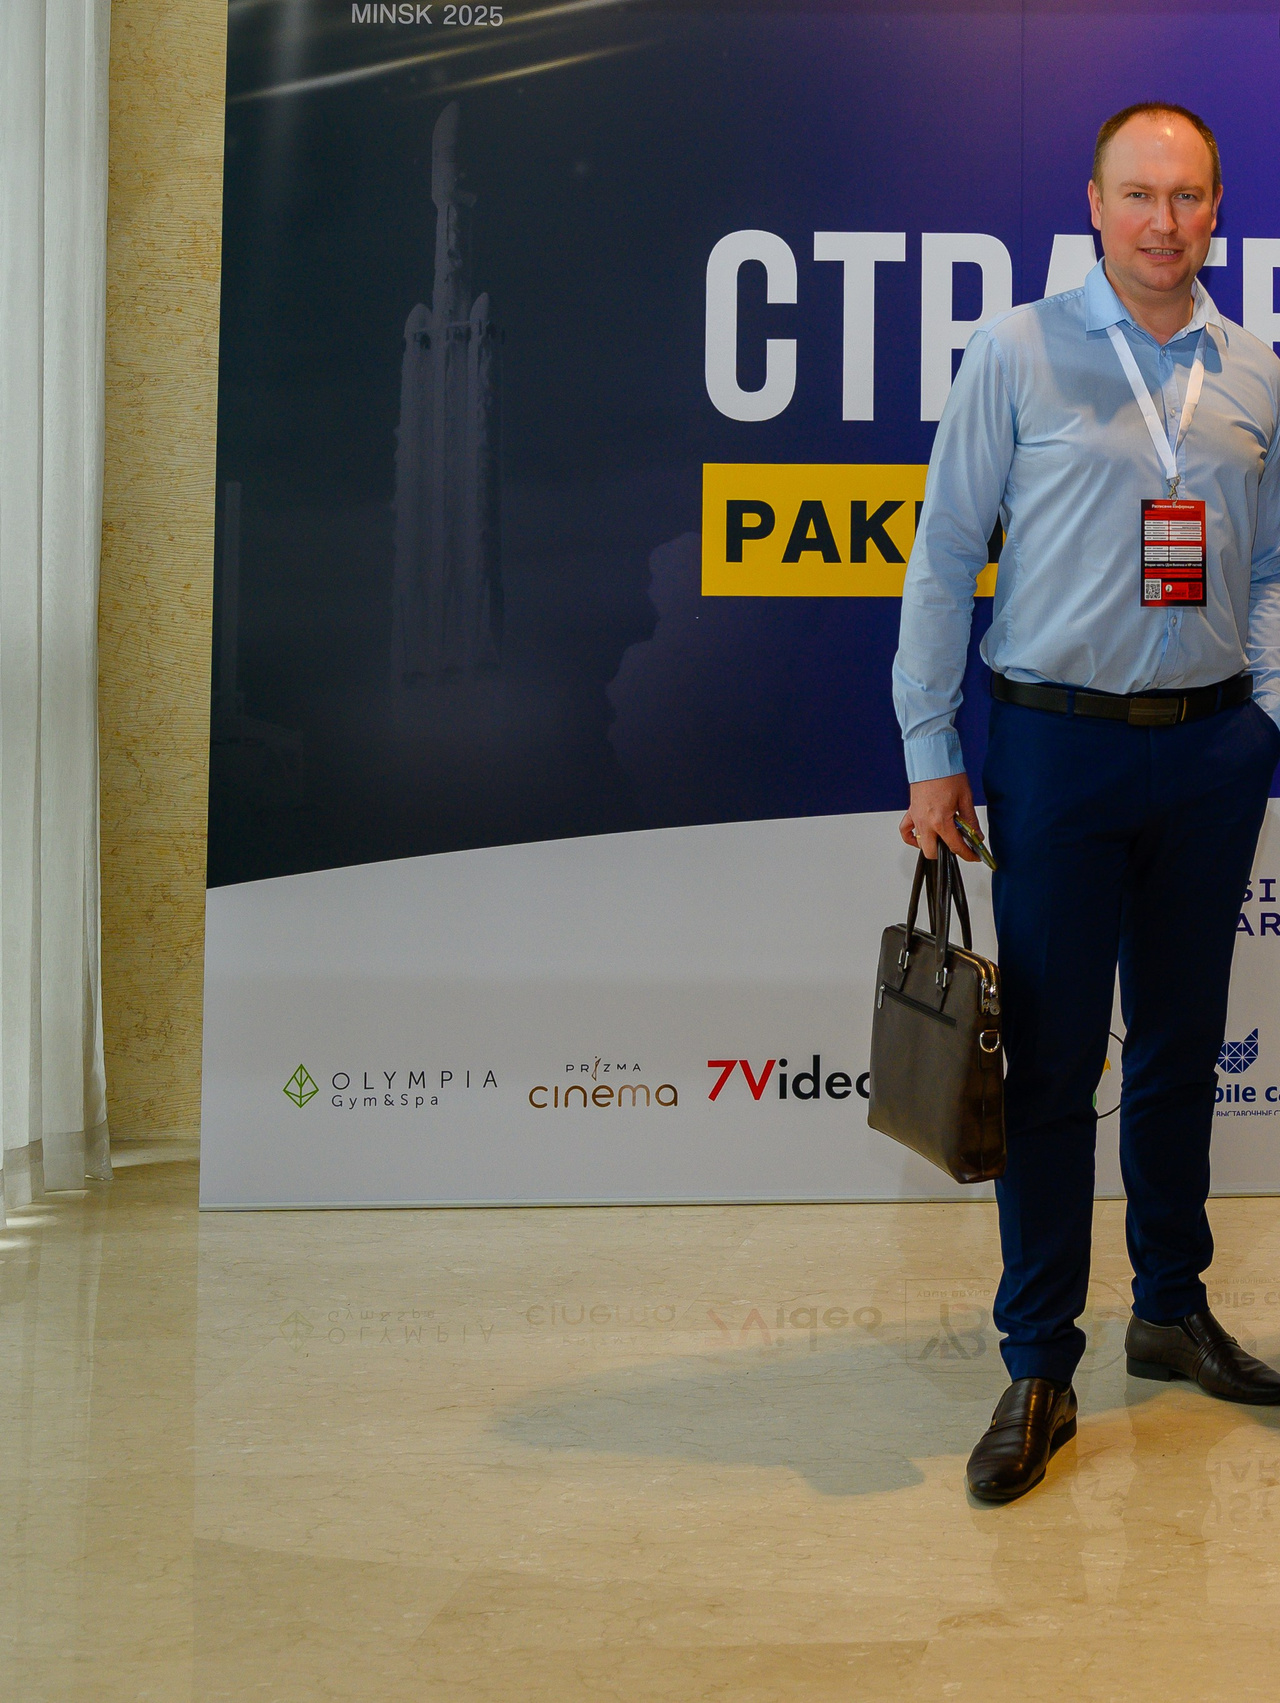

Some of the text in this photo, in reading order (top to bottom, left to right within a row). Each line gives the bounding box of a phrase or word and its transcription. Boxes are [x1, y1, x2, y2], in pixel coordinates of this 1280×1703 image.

[351, 3, 503, 26] MINSK 2025
[331, 1070, 498, 1091] OLYMPIA
[331, 1094, 439, 1110] Gym&Spa
[528, 1083, 679, 1109] cinema
